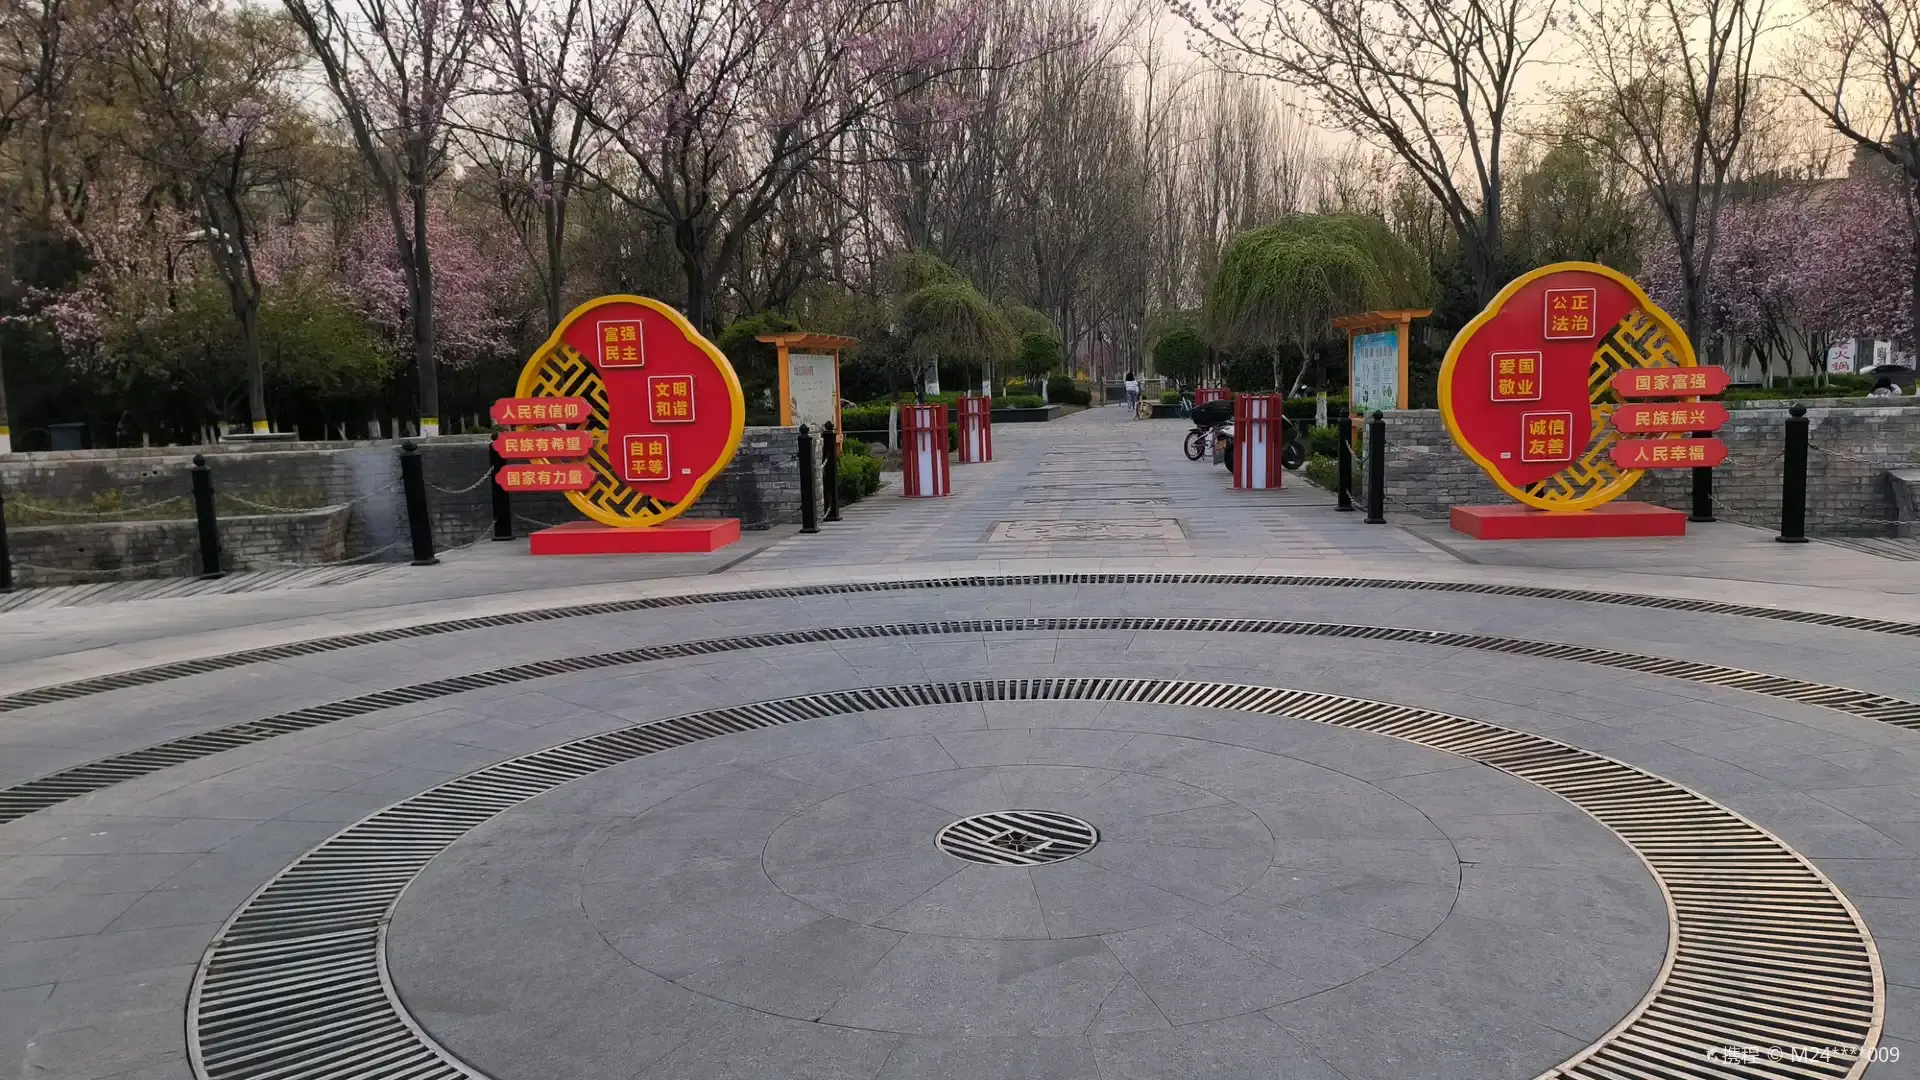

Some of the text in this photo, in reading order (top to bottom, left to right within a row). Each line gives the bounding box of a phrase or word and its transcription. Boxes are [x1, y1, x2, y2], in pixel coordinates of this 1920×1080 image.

[1552, 295, 1589, 311] 公正
[1552, 315, 1589, 332] 法治
[604, 326, 637, 342] 富强
[605, 346, 638, 361] 民主
[1499, 358, 1535, 375] 爱国
[655, 382, 687, 397] 文明
[1499, 379, 1534, 396] 敬业
[1635, 373, 1707, 391] 国家富强
[502, 403, 578, 420] 人民有信仰
[656, 401, 688, 417] 和谐
[1635, 409, 1706, 426] 民族振兴
[1529, 419, 1565, 436] 诚信
[505, 437, 581, 452] 民族有希望
[630, 441, 664, 457] 自由
[1529, 438, 1565, 455] 友善
[1634, 446, 1705, 462] 人民幸福
[631, 459, 664, 475] 平等
[507, 470, 583, 486] 国家有力量
